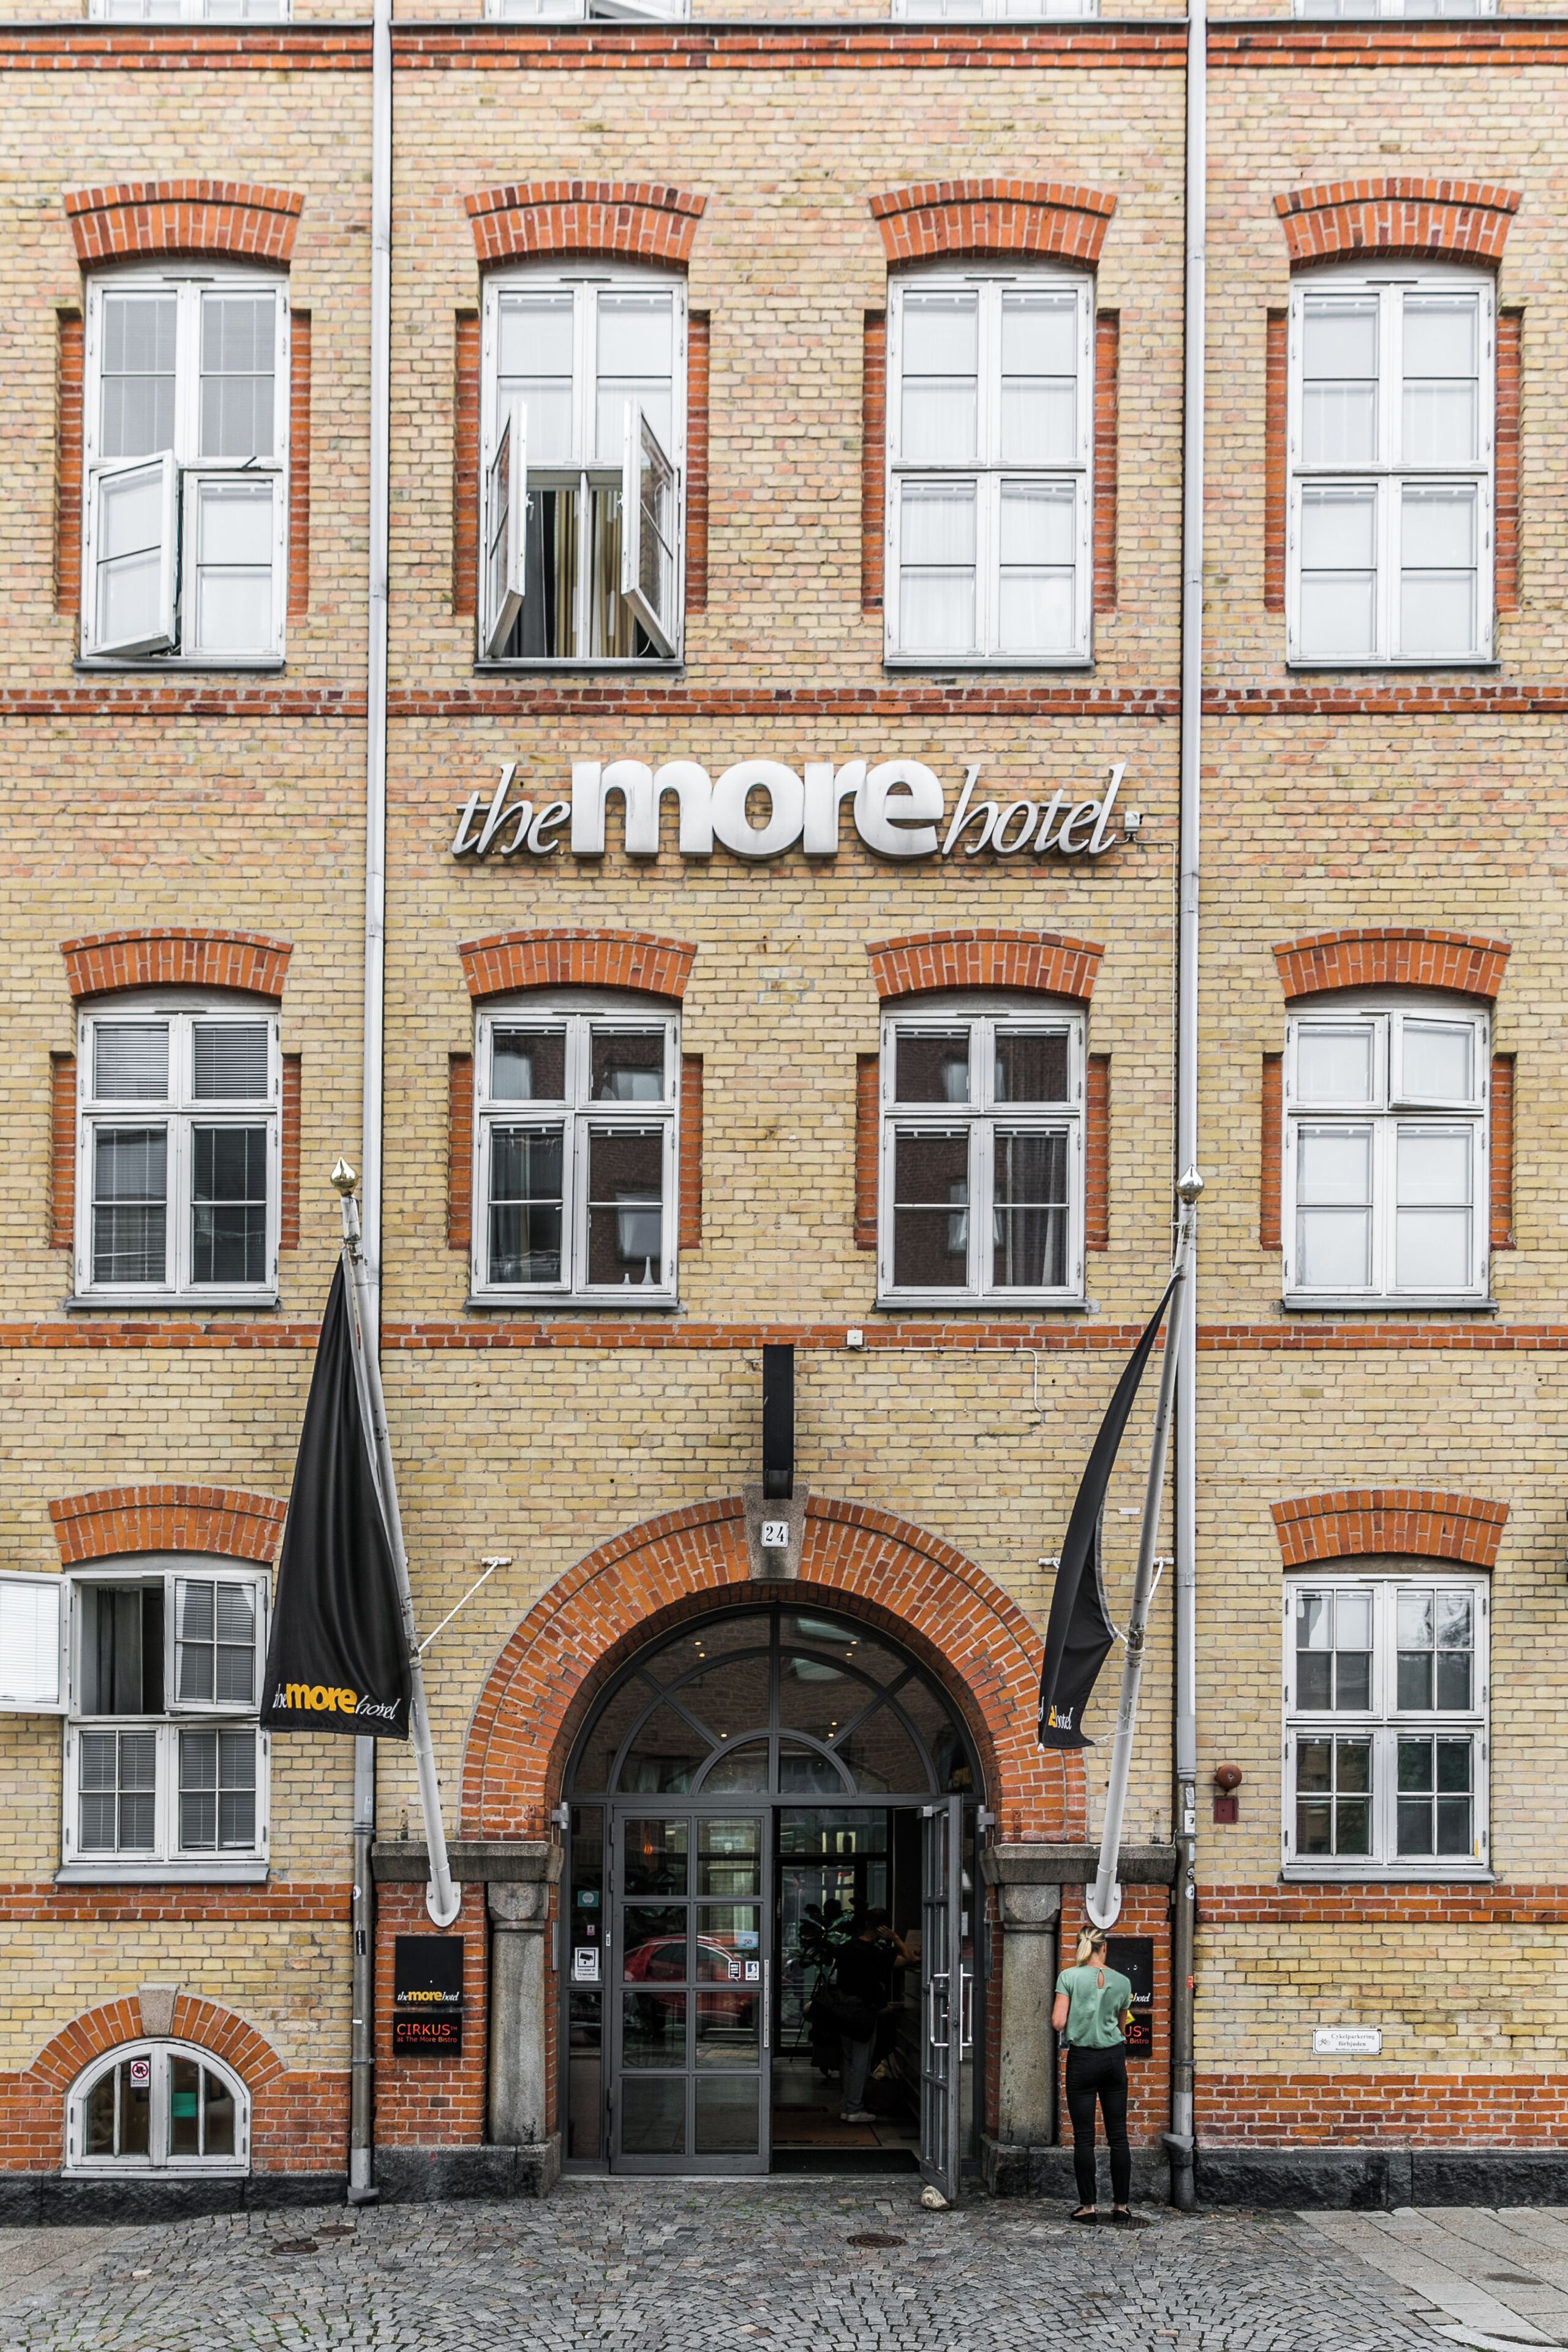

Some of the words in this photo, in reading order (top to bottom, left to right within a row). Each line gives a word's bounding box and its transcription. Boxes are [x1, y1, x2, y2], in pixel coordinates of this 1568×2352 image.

[451, 762, 571, 856] the
[571, 760, 944, 856] more
[941, 761, 1127, 856] hotel
[766, 1525, 785, 1542] 24
[286, 1683, 358, 1714] more
[355, 1695, 401, 1720] hotel
[408, 1991, 442, 2001] more
[442, 1991, 460, 2001] hotel
[1133, 1992, 1151, 2002] hotel
